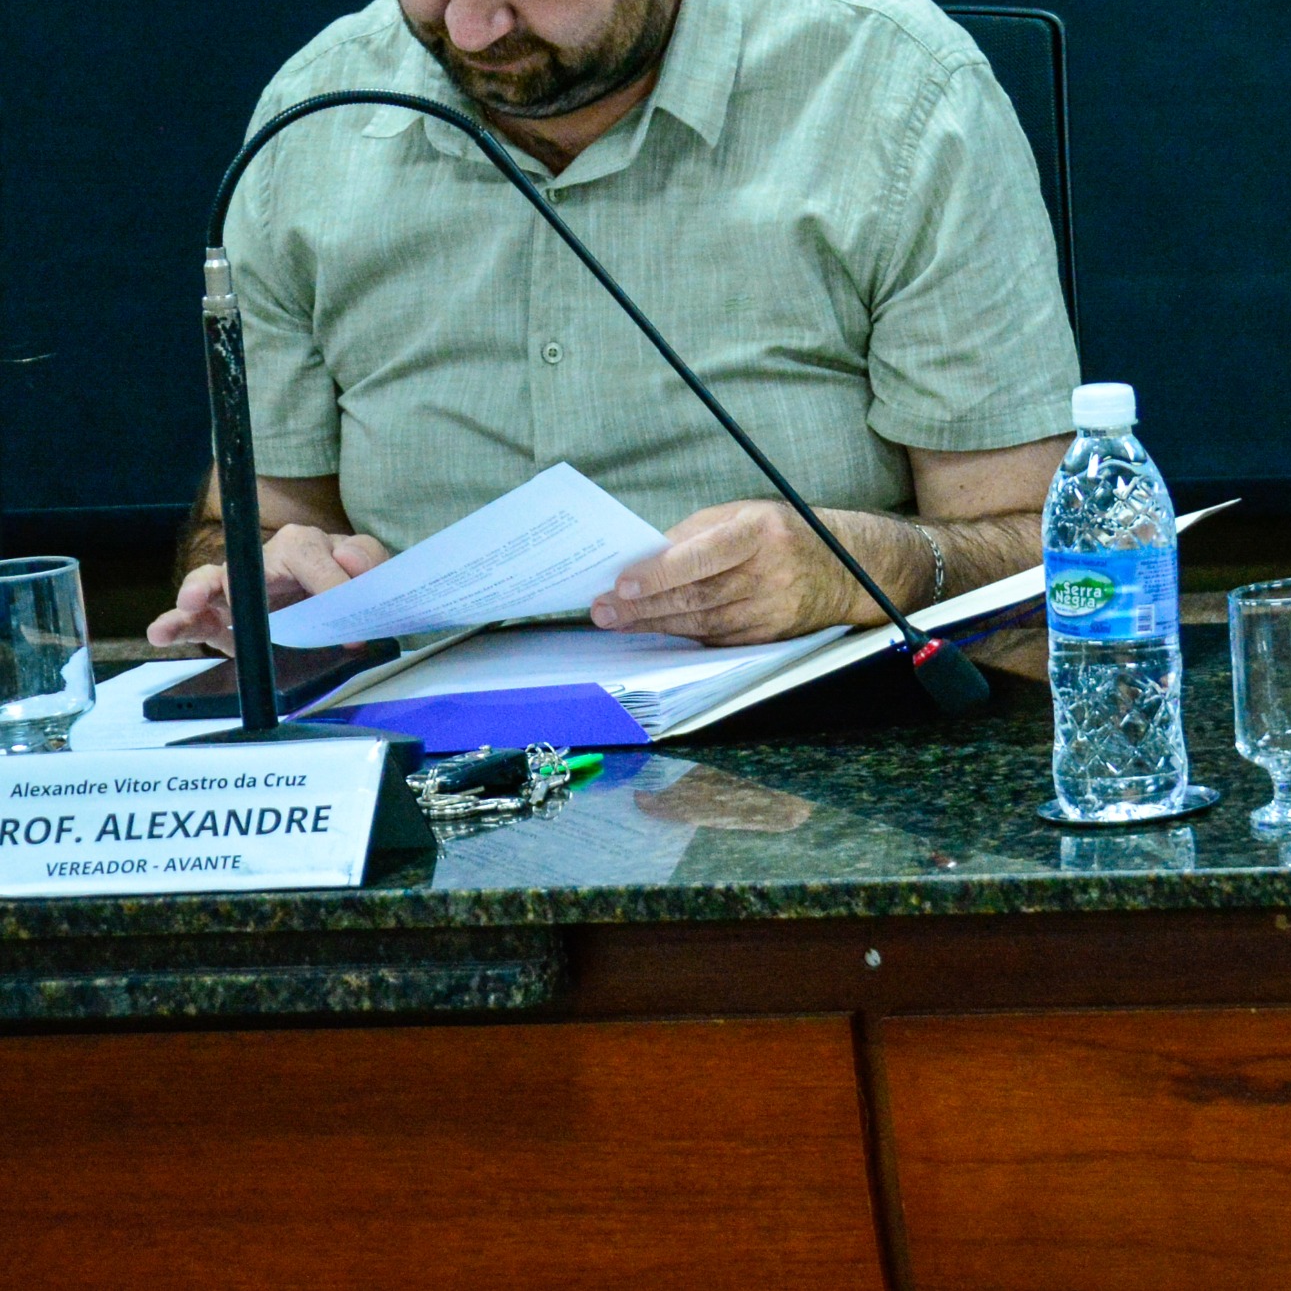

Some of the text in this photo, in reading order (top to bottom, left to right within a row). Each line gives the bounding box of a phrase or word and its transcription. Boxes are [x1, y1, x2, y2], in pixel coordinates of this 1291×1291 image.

[1055, 590, 1096, 609] Negra
[1063, 581, 1102, 598] Serra
[10, 772, 307, 798] Alexandre Vitor Castro da Cruz
[95, 804, 333, 843] ALEXANDRE
[46, 859, 147, 877] VEREADOR
[164, 855, 242, 872] AVANTE
